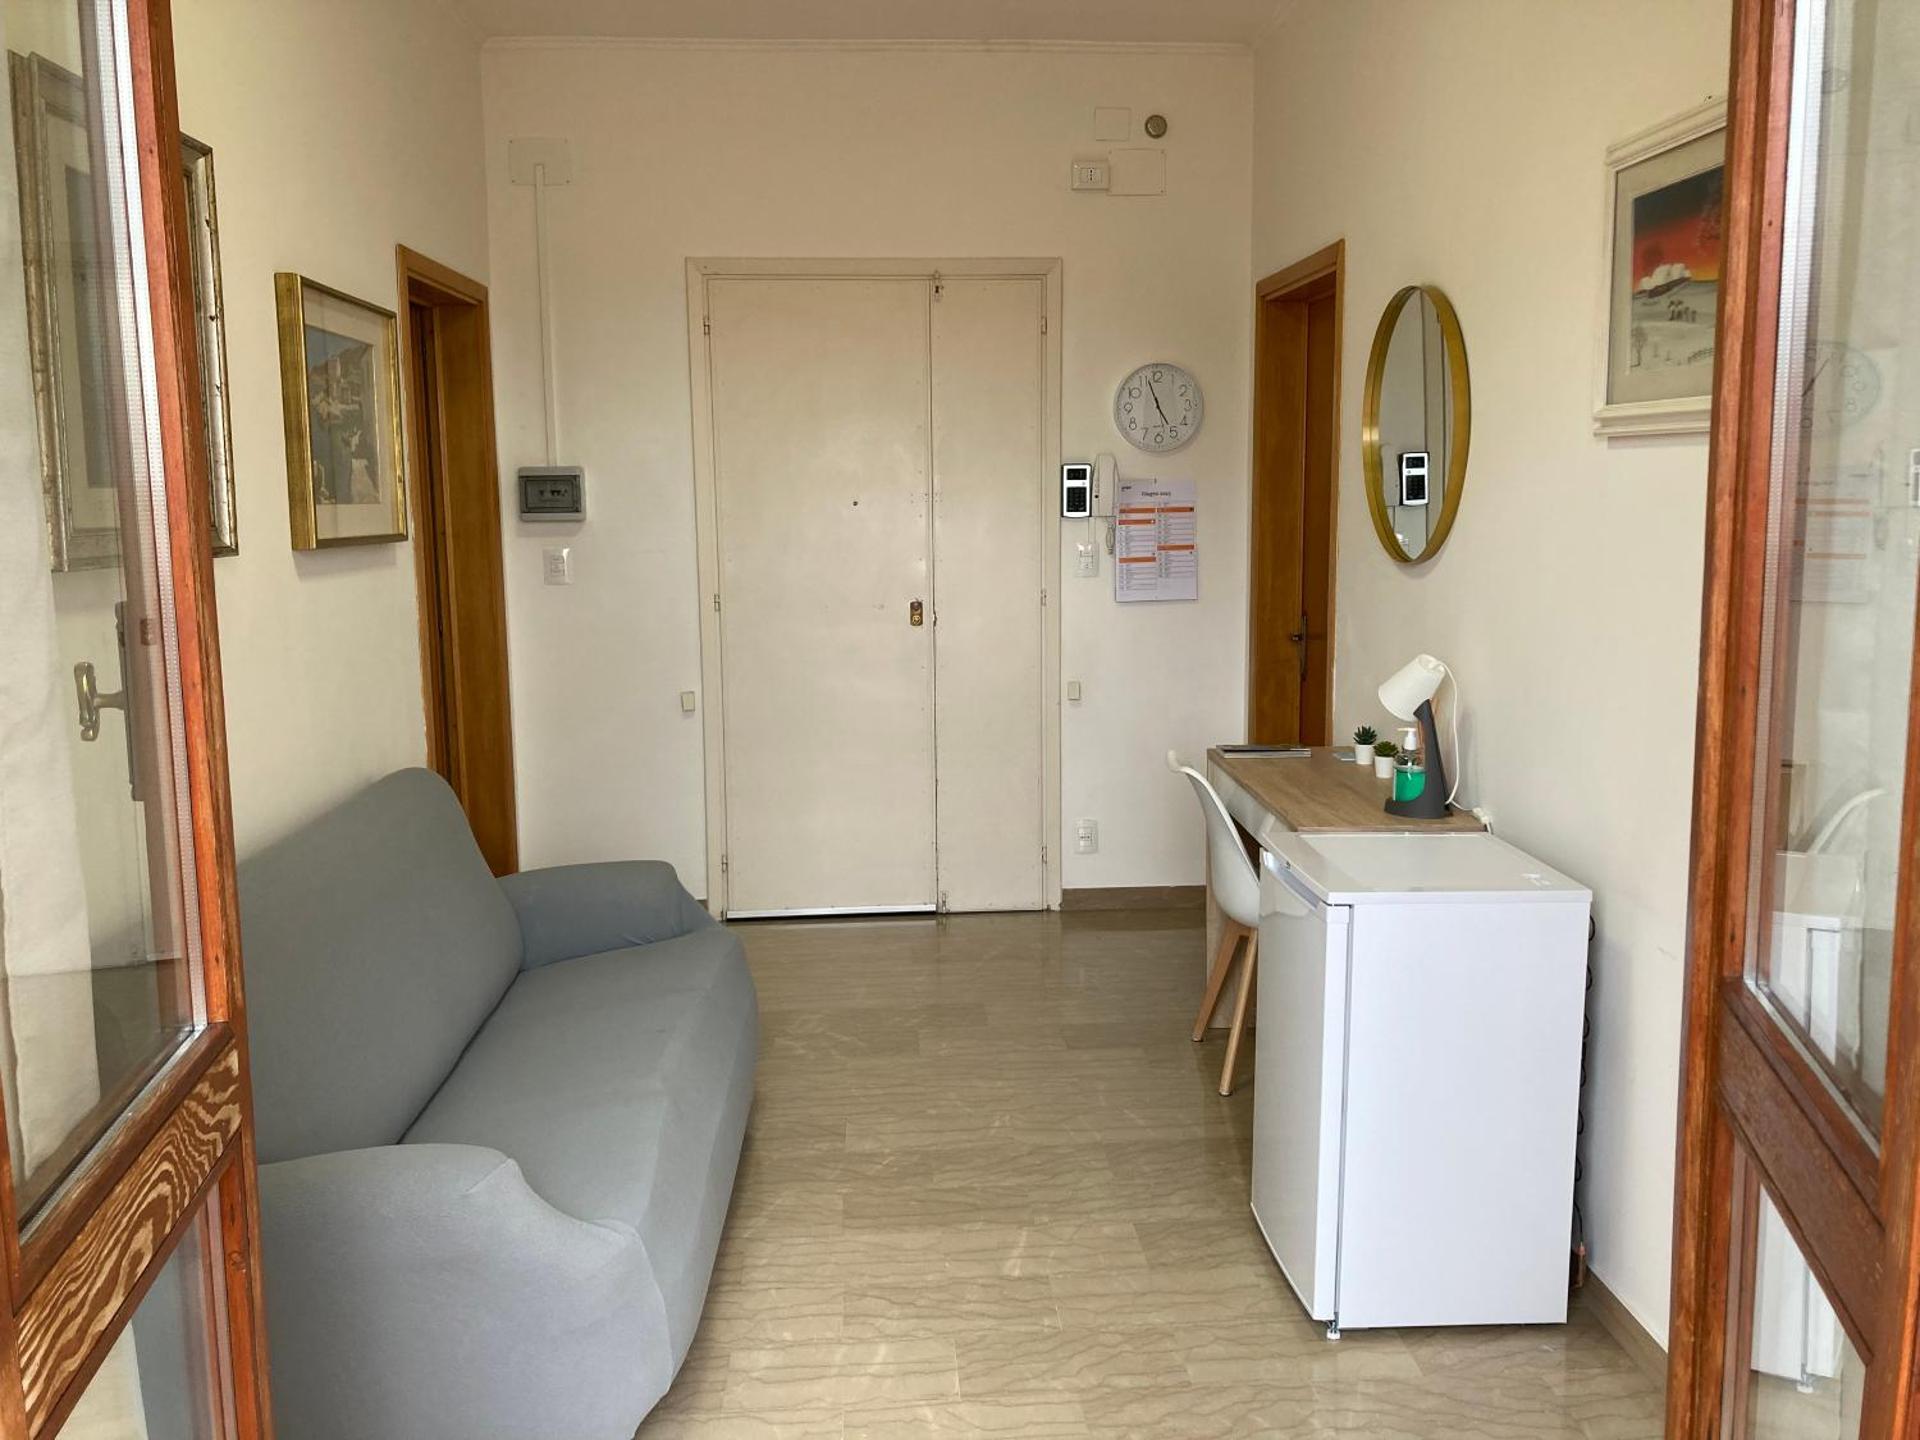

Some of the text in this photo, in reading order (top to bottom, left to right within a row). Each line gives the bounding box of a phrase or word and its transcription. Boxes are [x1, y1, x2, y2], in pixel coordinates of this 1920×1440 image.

[1151, 370, 1163, 383] 12
[1128, 386, 1141, 399] 10
[1179, 384, 1188, 397] 2
[1124, 402, 1133, 415] 9
[1184, 399, 1192, 411] 3
[1129, 416, 1137, 430] 8
[1180, 415, 1188, 426] 4
[1141, 427, 1149, 440] 7
[1169, 426, 1178, 439] 5
